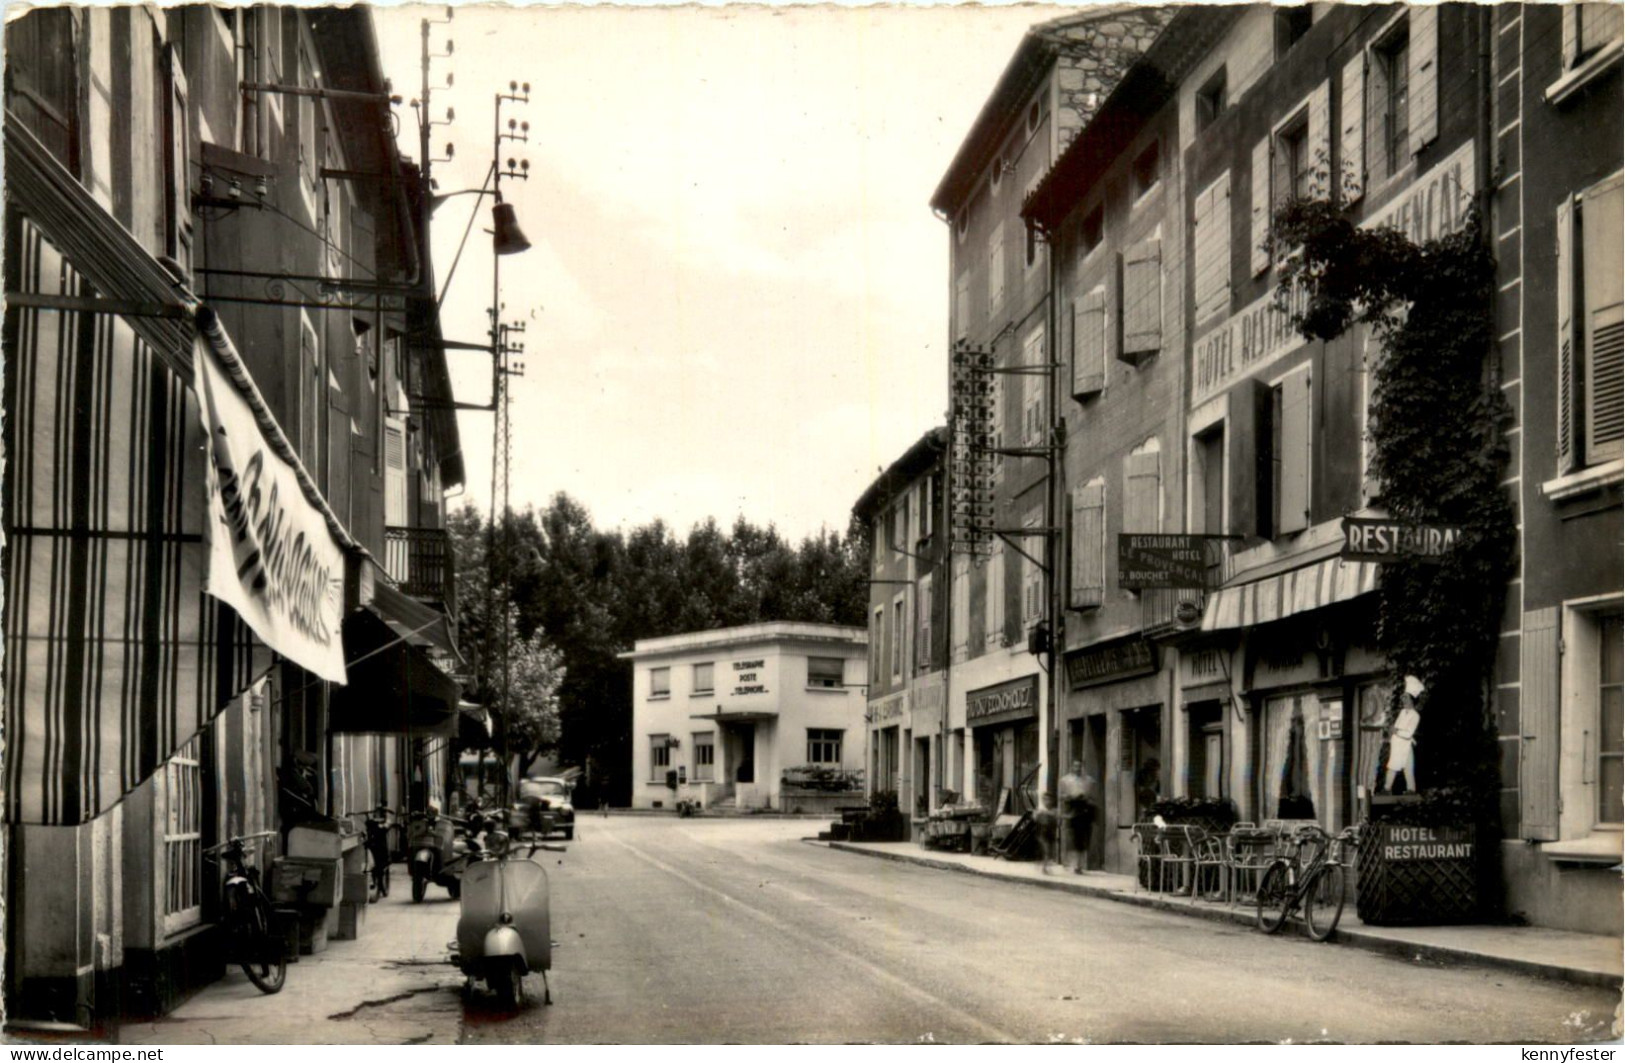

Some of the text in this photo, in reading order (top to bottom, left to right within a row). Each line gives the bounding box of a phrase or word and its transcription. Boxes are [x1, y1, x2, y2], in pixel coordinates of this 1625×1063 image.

[1131, 536, 1191, 549] RESTAURANT
[1390, 827, 1437, 842] HOTEL
[1384, 843, 1472, 860] RESTAURANT
